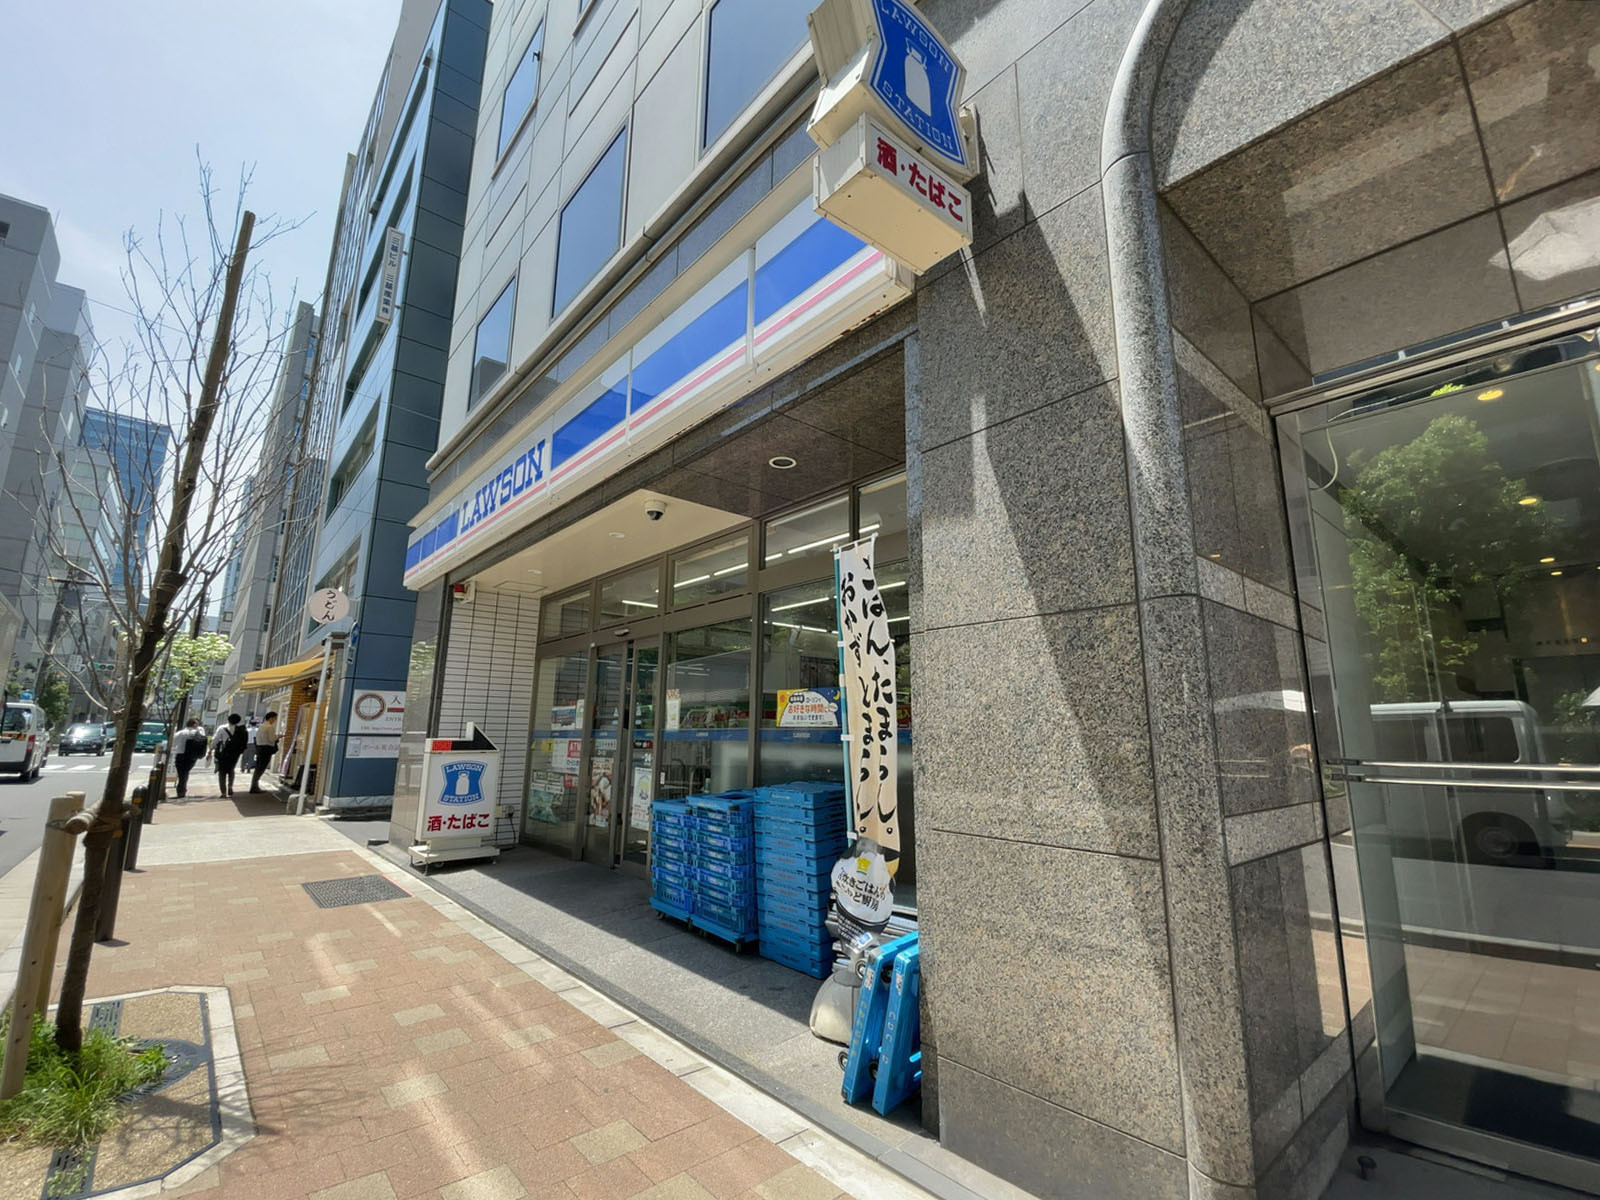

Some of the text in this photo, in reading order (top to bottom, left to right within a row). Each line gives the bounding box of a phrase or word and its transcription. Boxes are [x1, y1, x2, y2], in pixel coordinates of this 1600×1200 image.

[879, 0, 950, 73] LAWSON
[882, 79, 953, 151] STATION
[877, 136, 963, 222] 酒・たばこ
[460, 439, 546, 534] LAWSON
[322, 590, 337, 621] うどん
[446, 764, 482, 772] LAWSON
[427, 813, 490, 832] 酒・たばこ
[442, 793, 480, 803] STATION
